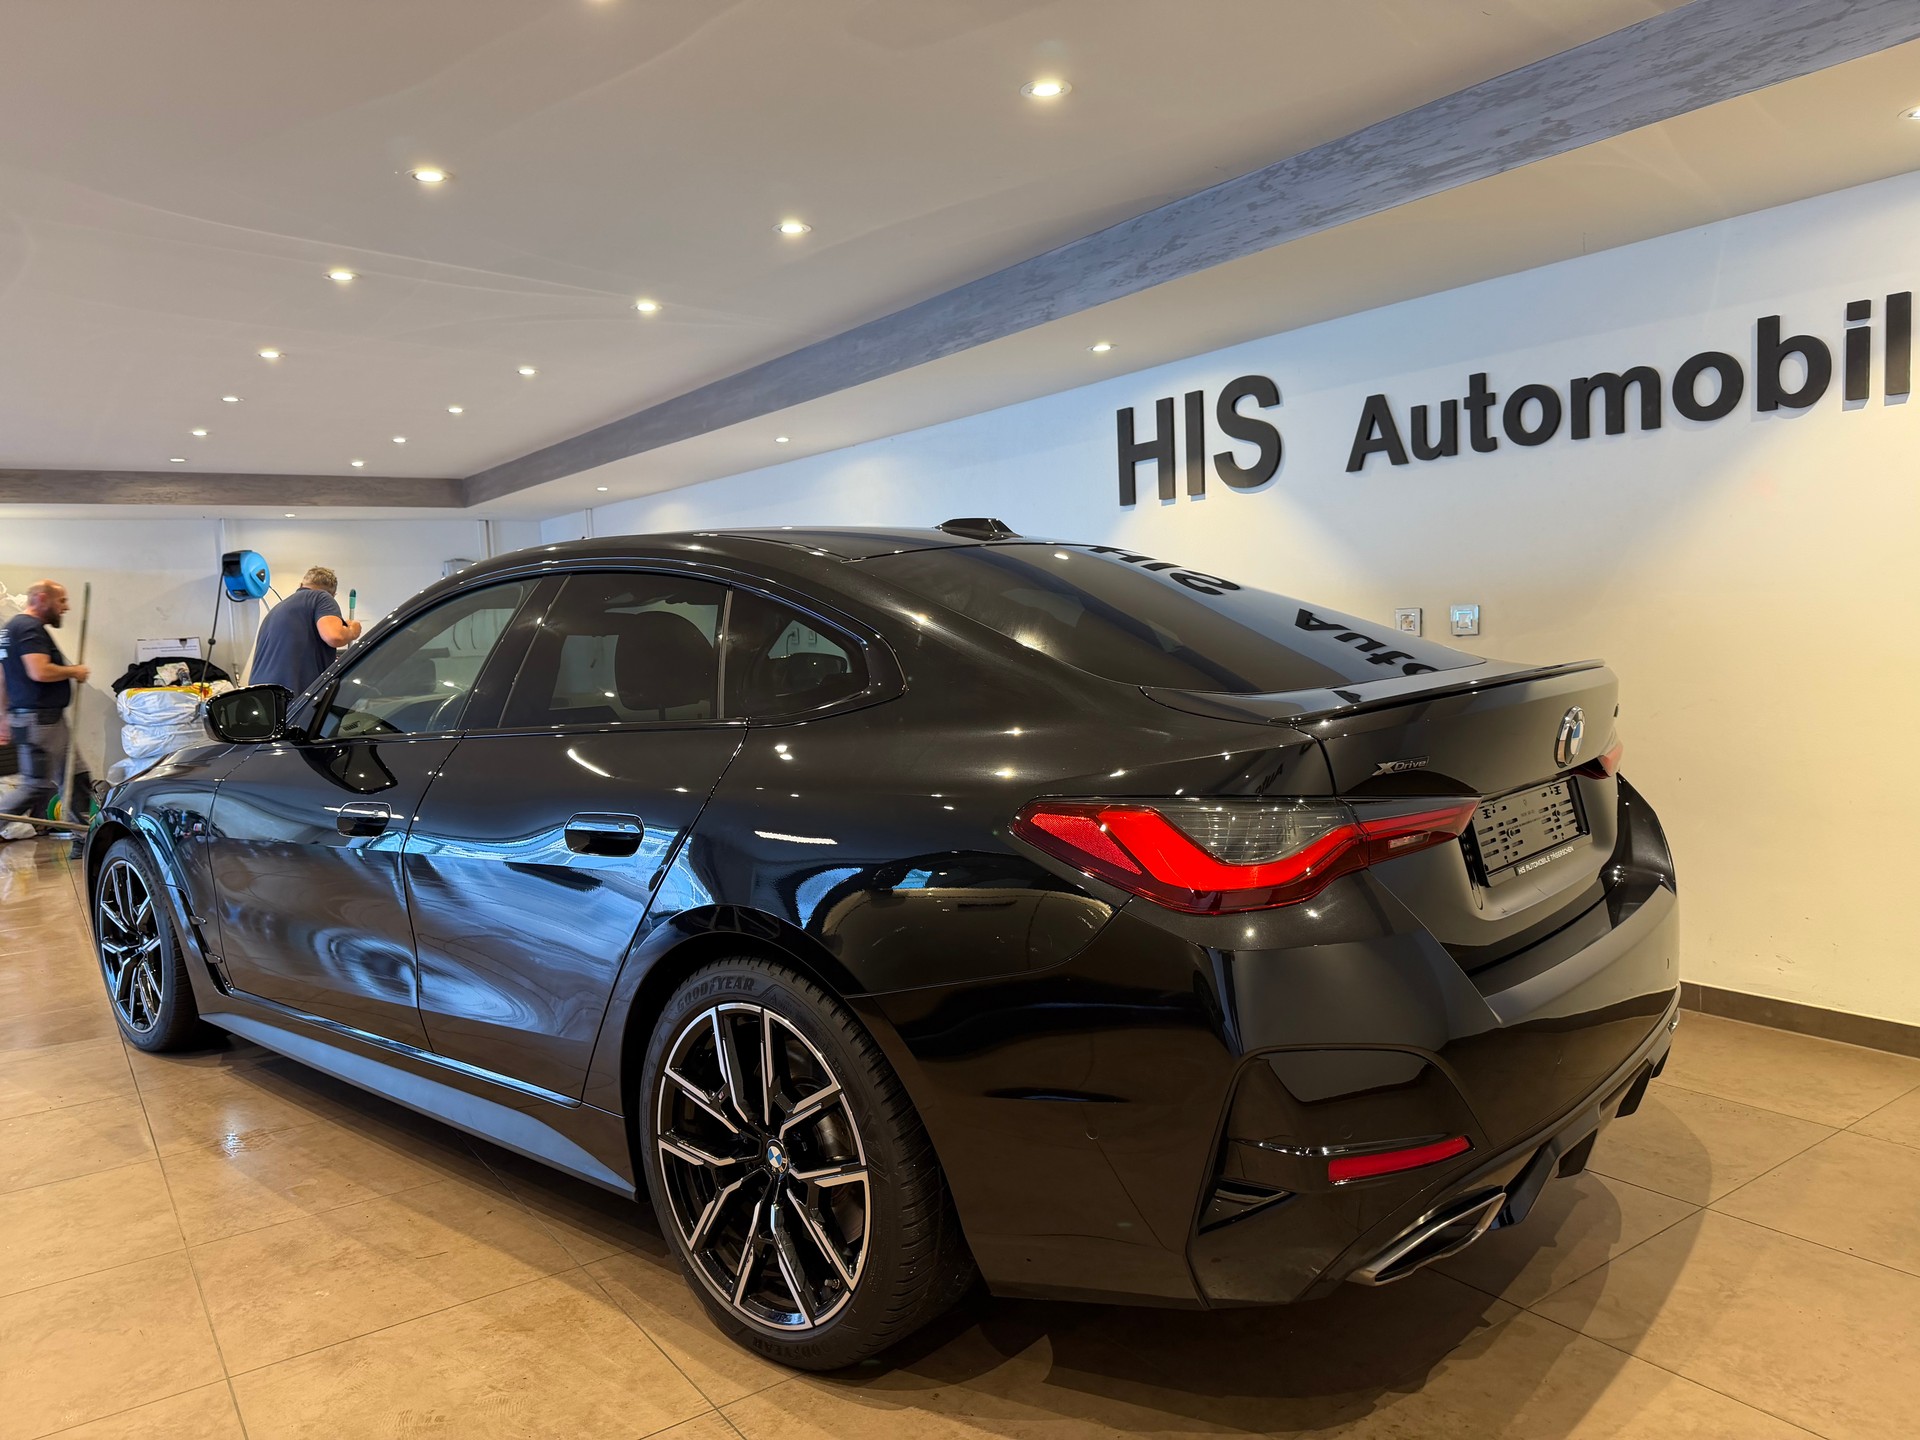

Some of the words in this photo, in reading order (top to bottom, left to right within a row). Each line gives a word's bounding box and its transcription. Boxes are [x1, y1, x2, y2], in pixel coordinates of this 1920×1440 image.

[1116, 374, 1283, 507] HIS
[1345, 290, 1912, 473] Automobil
[676, 975, 756, 1014] GOODYEAR
